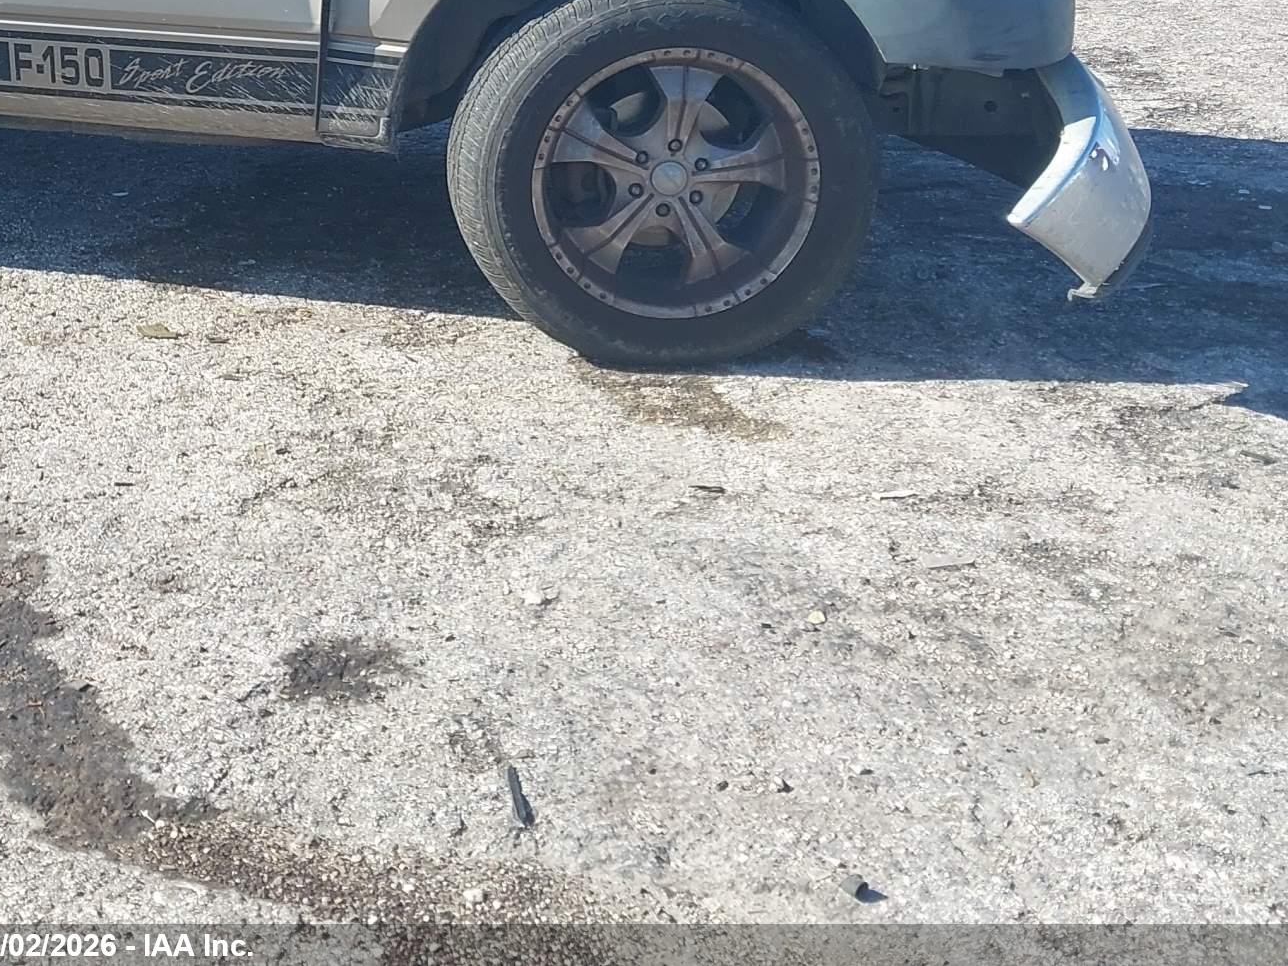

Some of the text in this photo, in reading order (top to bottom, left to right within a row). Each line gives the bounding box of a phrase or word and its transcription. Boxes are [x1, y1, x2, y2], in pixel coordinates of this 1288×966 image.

[14, 42, 104, 88] F-150
[119, 57, 291, 94] Sport Edition
